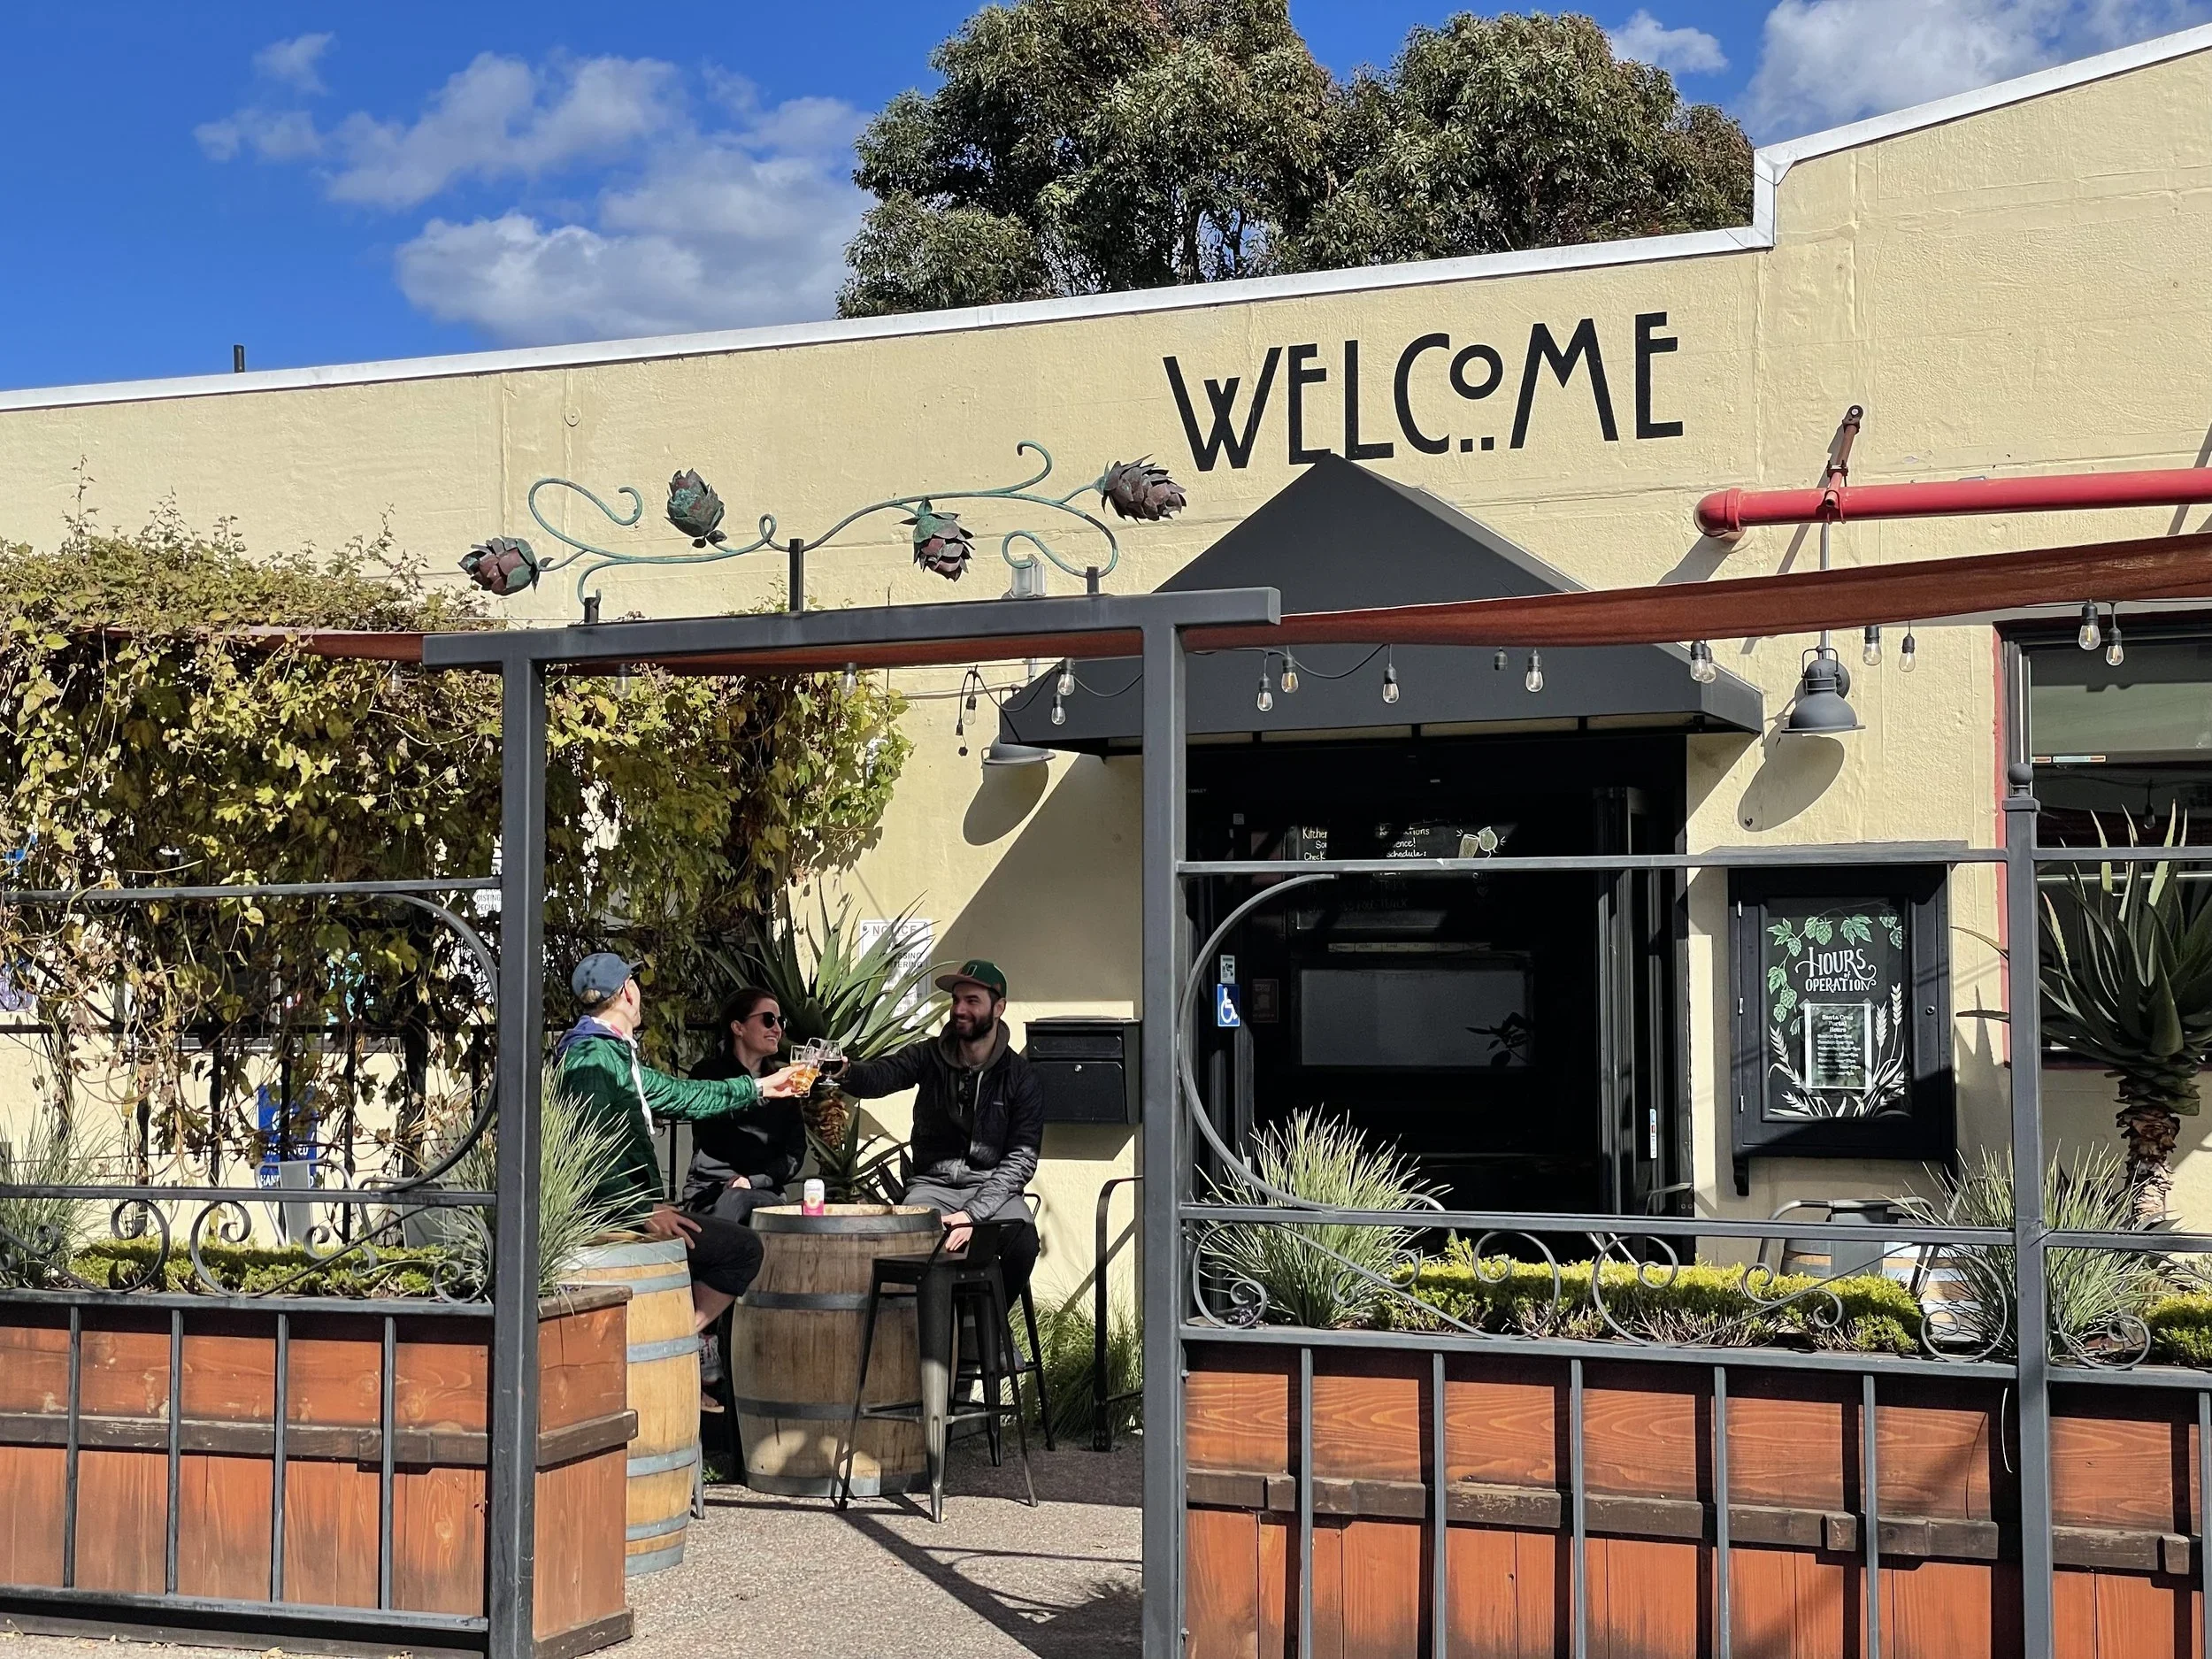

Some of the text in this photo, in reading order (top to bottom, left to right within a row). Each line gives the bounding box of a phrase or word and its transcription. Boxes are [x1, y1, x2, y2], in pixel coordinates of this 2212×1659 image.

[1162, 311, 1685, 472] WELCOME
[1795, 947, 1877, 981] HOURS
[1843, 970, 1851, 979] of
[1805, 977, 1877, 994] OPERATION
